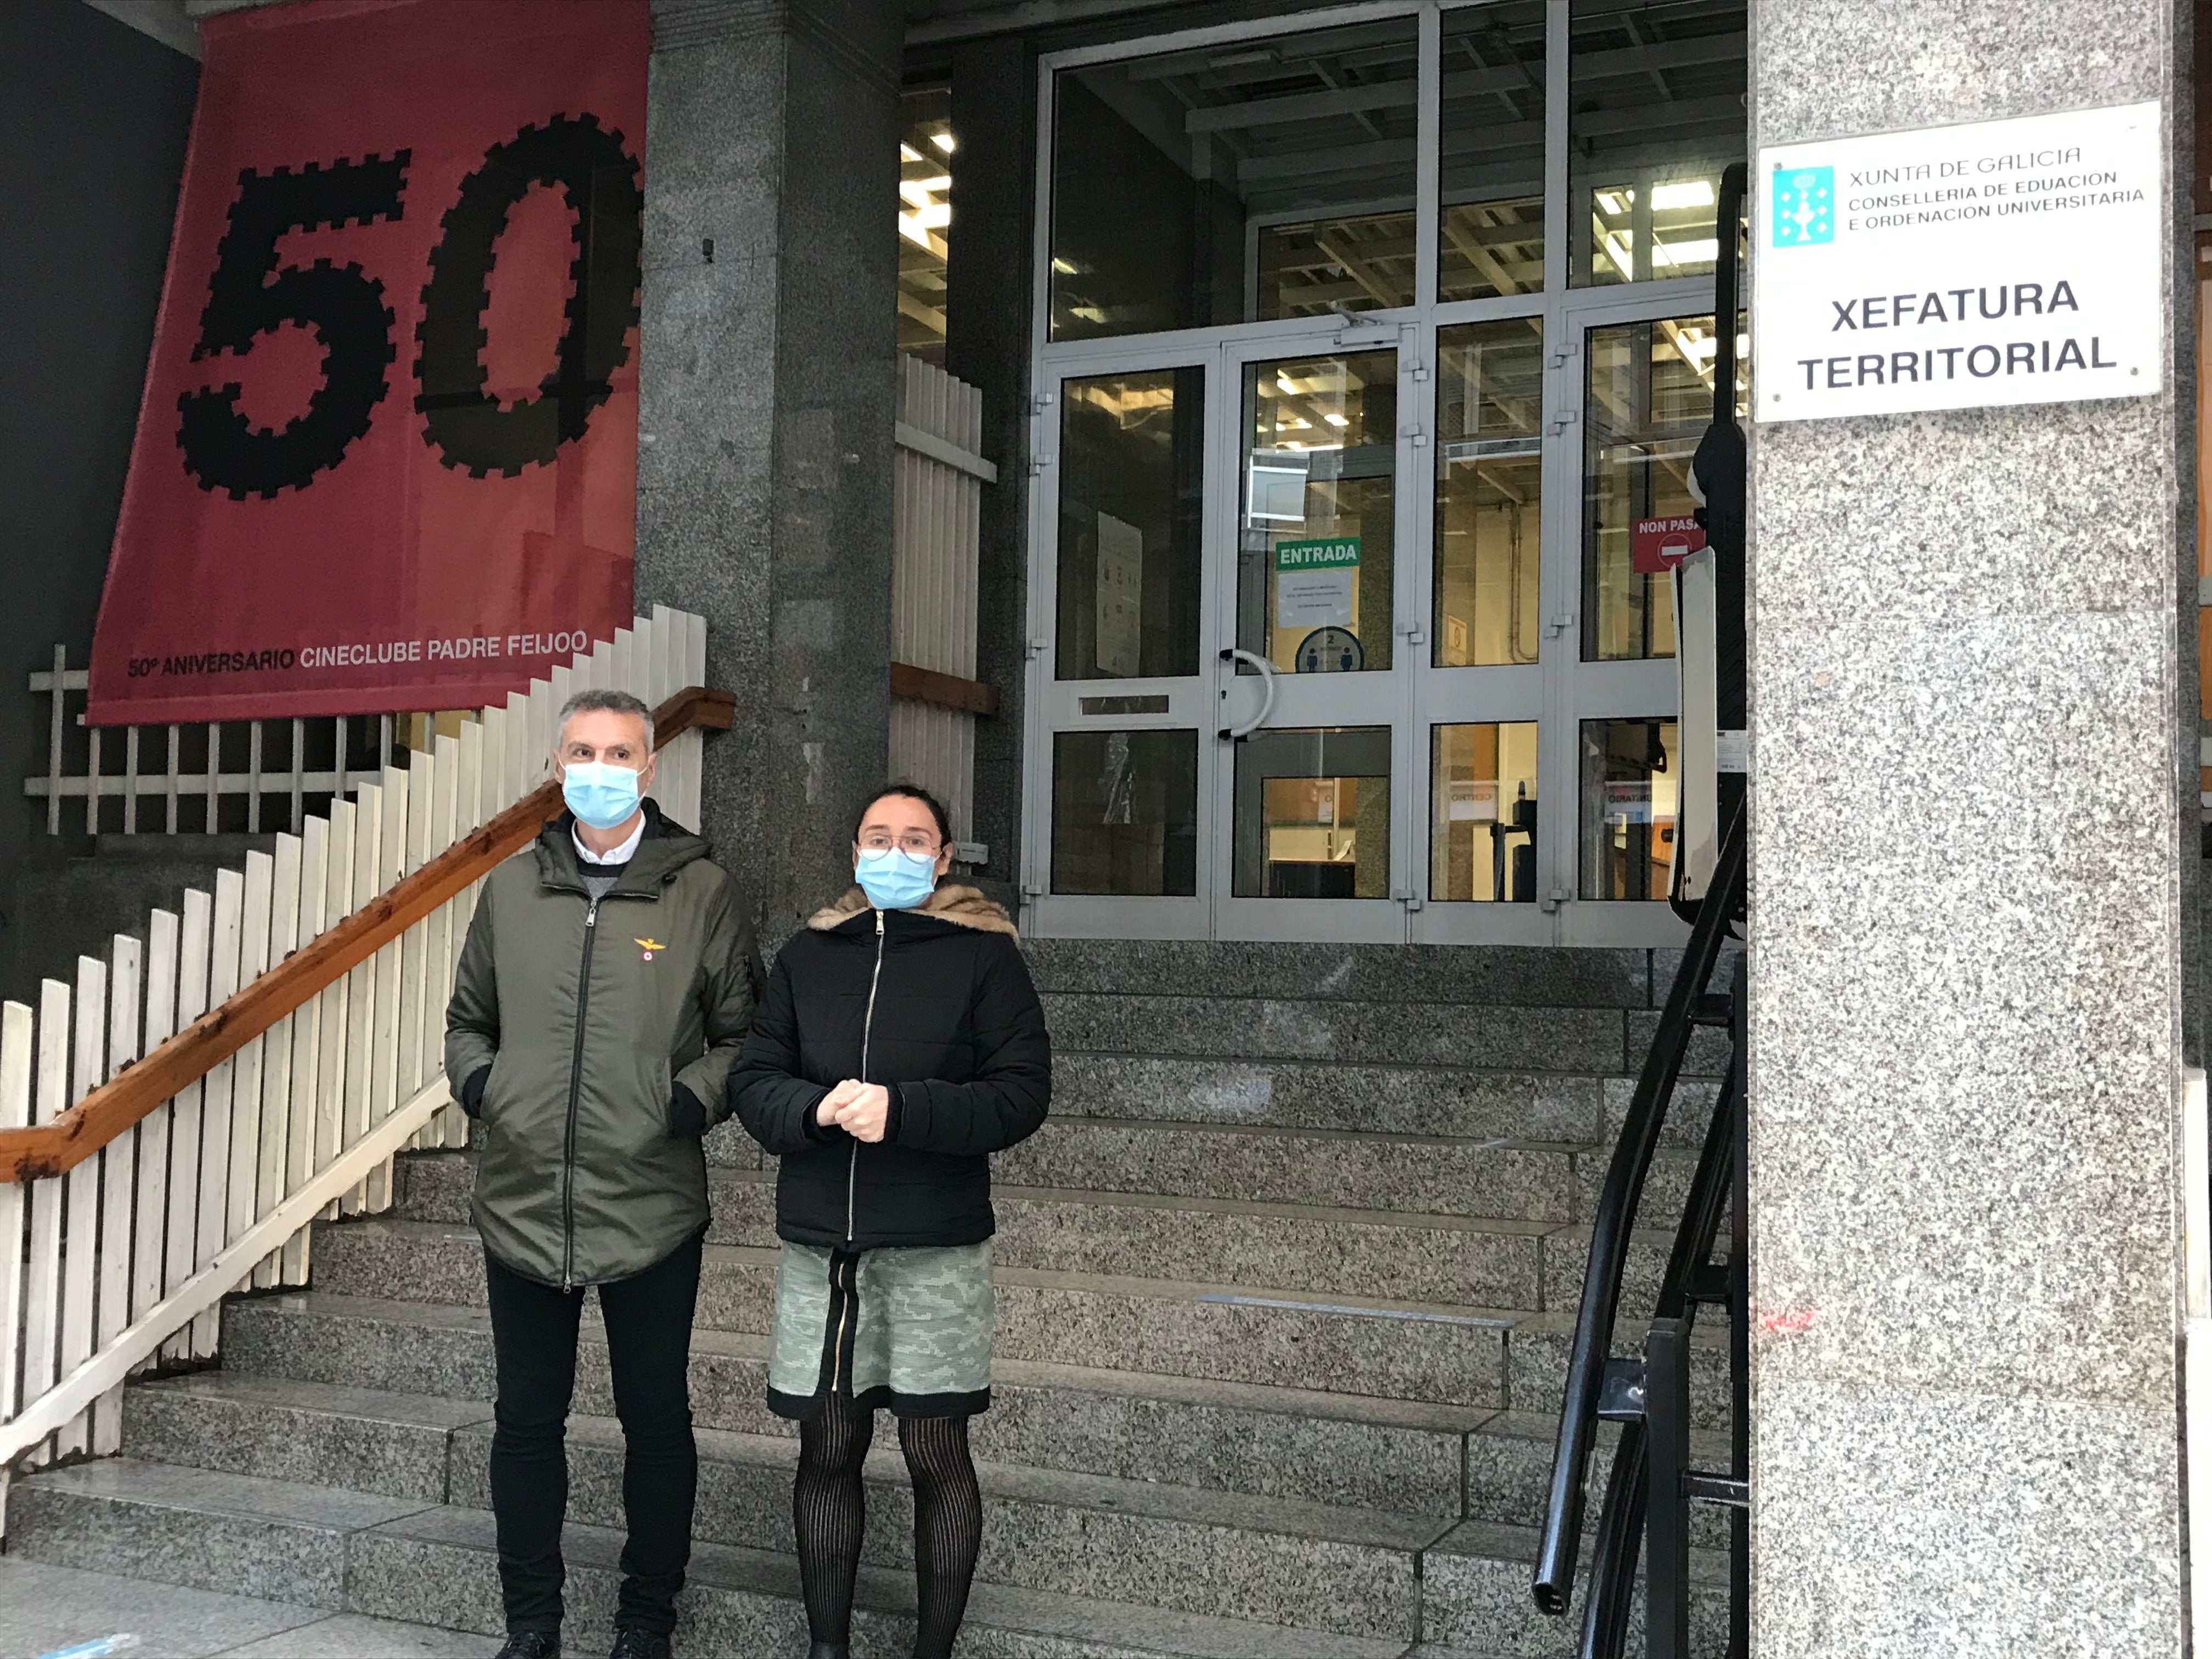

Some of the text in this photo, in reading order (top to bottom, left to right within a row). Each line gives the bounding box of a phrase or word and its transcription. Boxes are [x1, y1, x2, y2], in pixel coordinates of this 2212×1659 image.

[1849, 147, 2080, 187] XUNTA DE GALICIA
[1849, 218, 1859, 230] E
[1997, 189, 2145, 216] UNIVERSITARIA
[1984, 183, 2008, 197] DE
[177, 112, 644, 501] 50
[1831, 280, 2079, 332] XEFATURA
[1797, 336, 2118, 390] TERRITORIAL
[1639, 520, 1667, 534] NON
[1280, 544, 1357, 565] ENTRADA
[160, 648, 295, 676] ANIVERSARIO
[300, 640, 421, 668] CINECLUBE
[427, 636, 501, 661] PADRE
[507, 630, 587, 656] FEIJOO
[1328, 634, 1334, 644] 2
